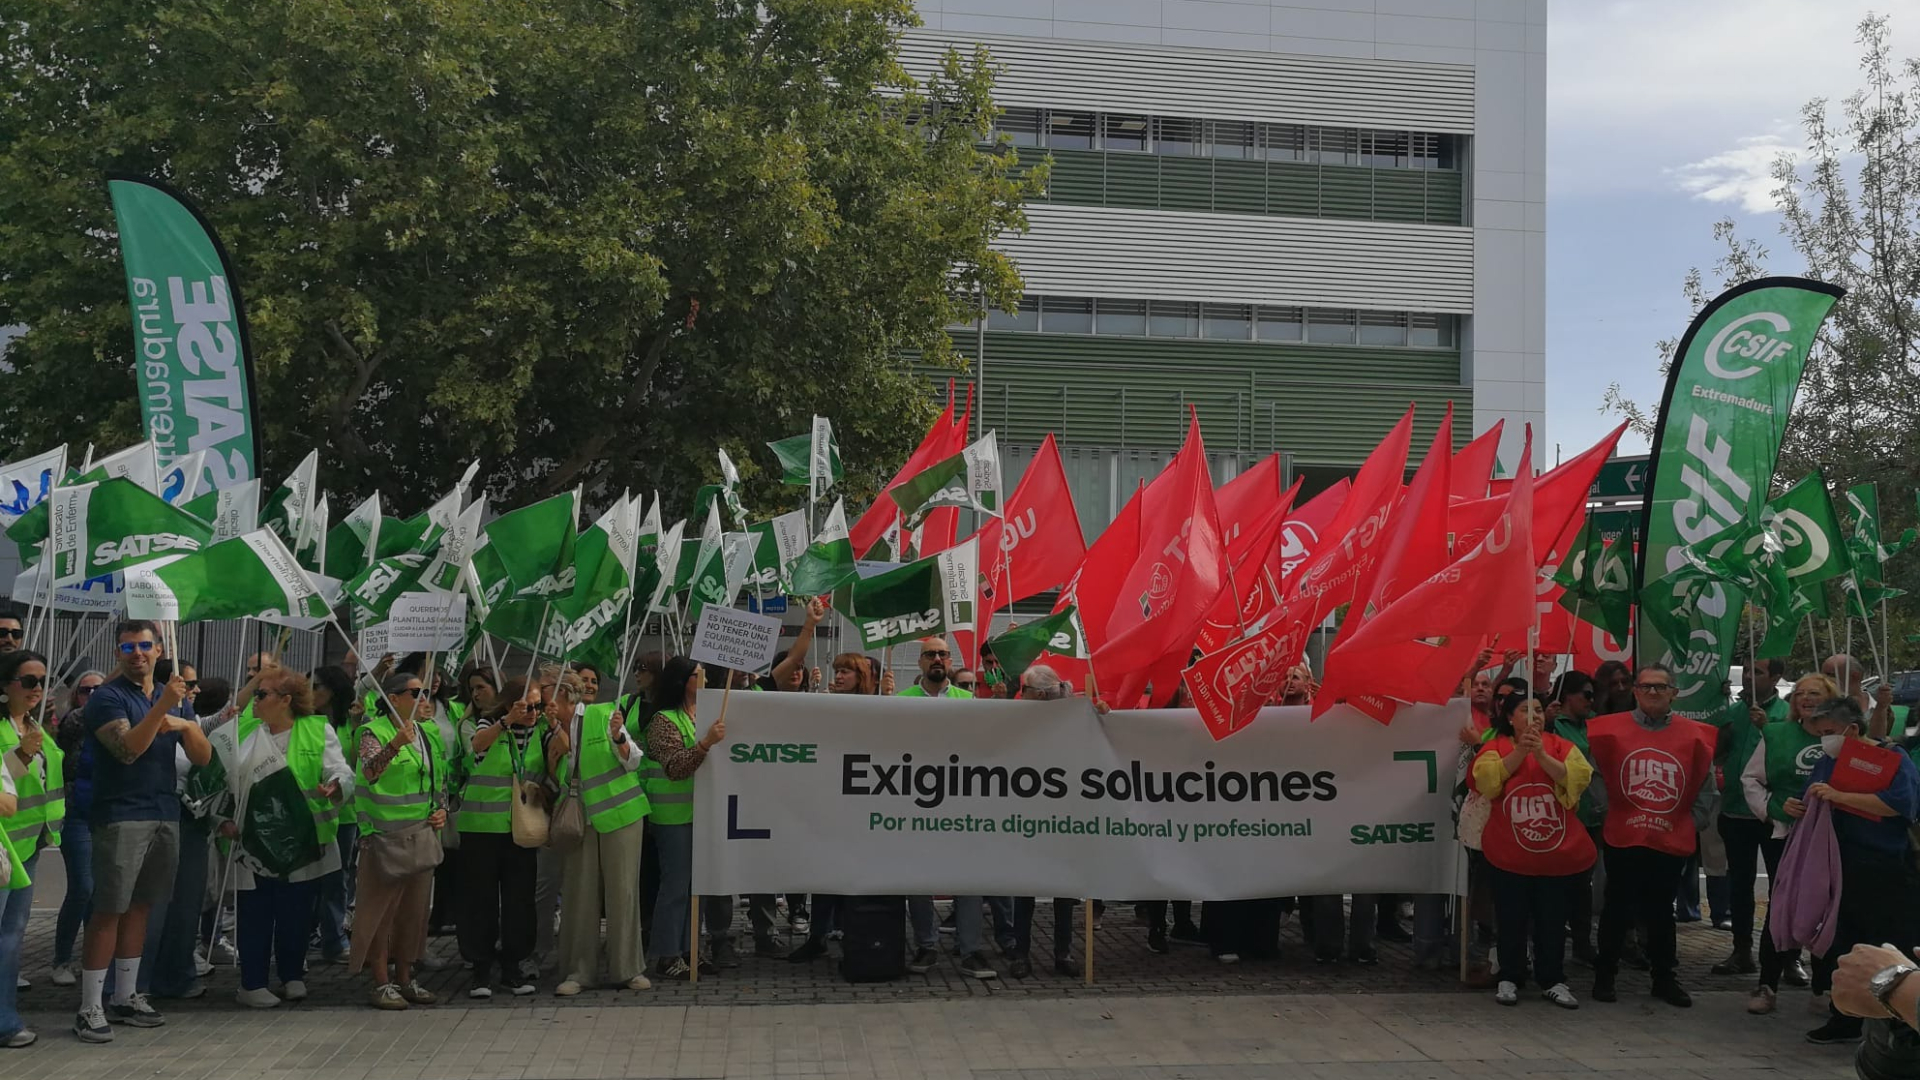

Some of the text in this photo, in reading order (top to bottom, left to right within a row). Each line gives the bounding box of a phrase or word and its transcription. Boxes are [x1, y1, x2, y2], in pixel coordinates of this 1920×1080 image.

[1723, 330, 1794, 363] CSIF
[93, 533, 201, 566] SATSE
[706, 622, 720, 631] NO
[722, 625, 749, 638] TENER
[751, 631, 769, 643] UNA
[708, 614, 773, 635] ES INACEPTABLE
[702, 640, 765, 660] SALARIAL PARA
[717, 653, 745, 666] EL SES
[729, 743, 818, 764] SATSE
[841, 753, 1338, 809] Exigimos soluciones
[1629, 759, 1679, 790] UGT
[1511, 793, 1560, 824] UGT
[869, 812, 1312, 843] Por nuestra dignidad laboral y profesional
[1350, 822, 1436, 845] SATSE
